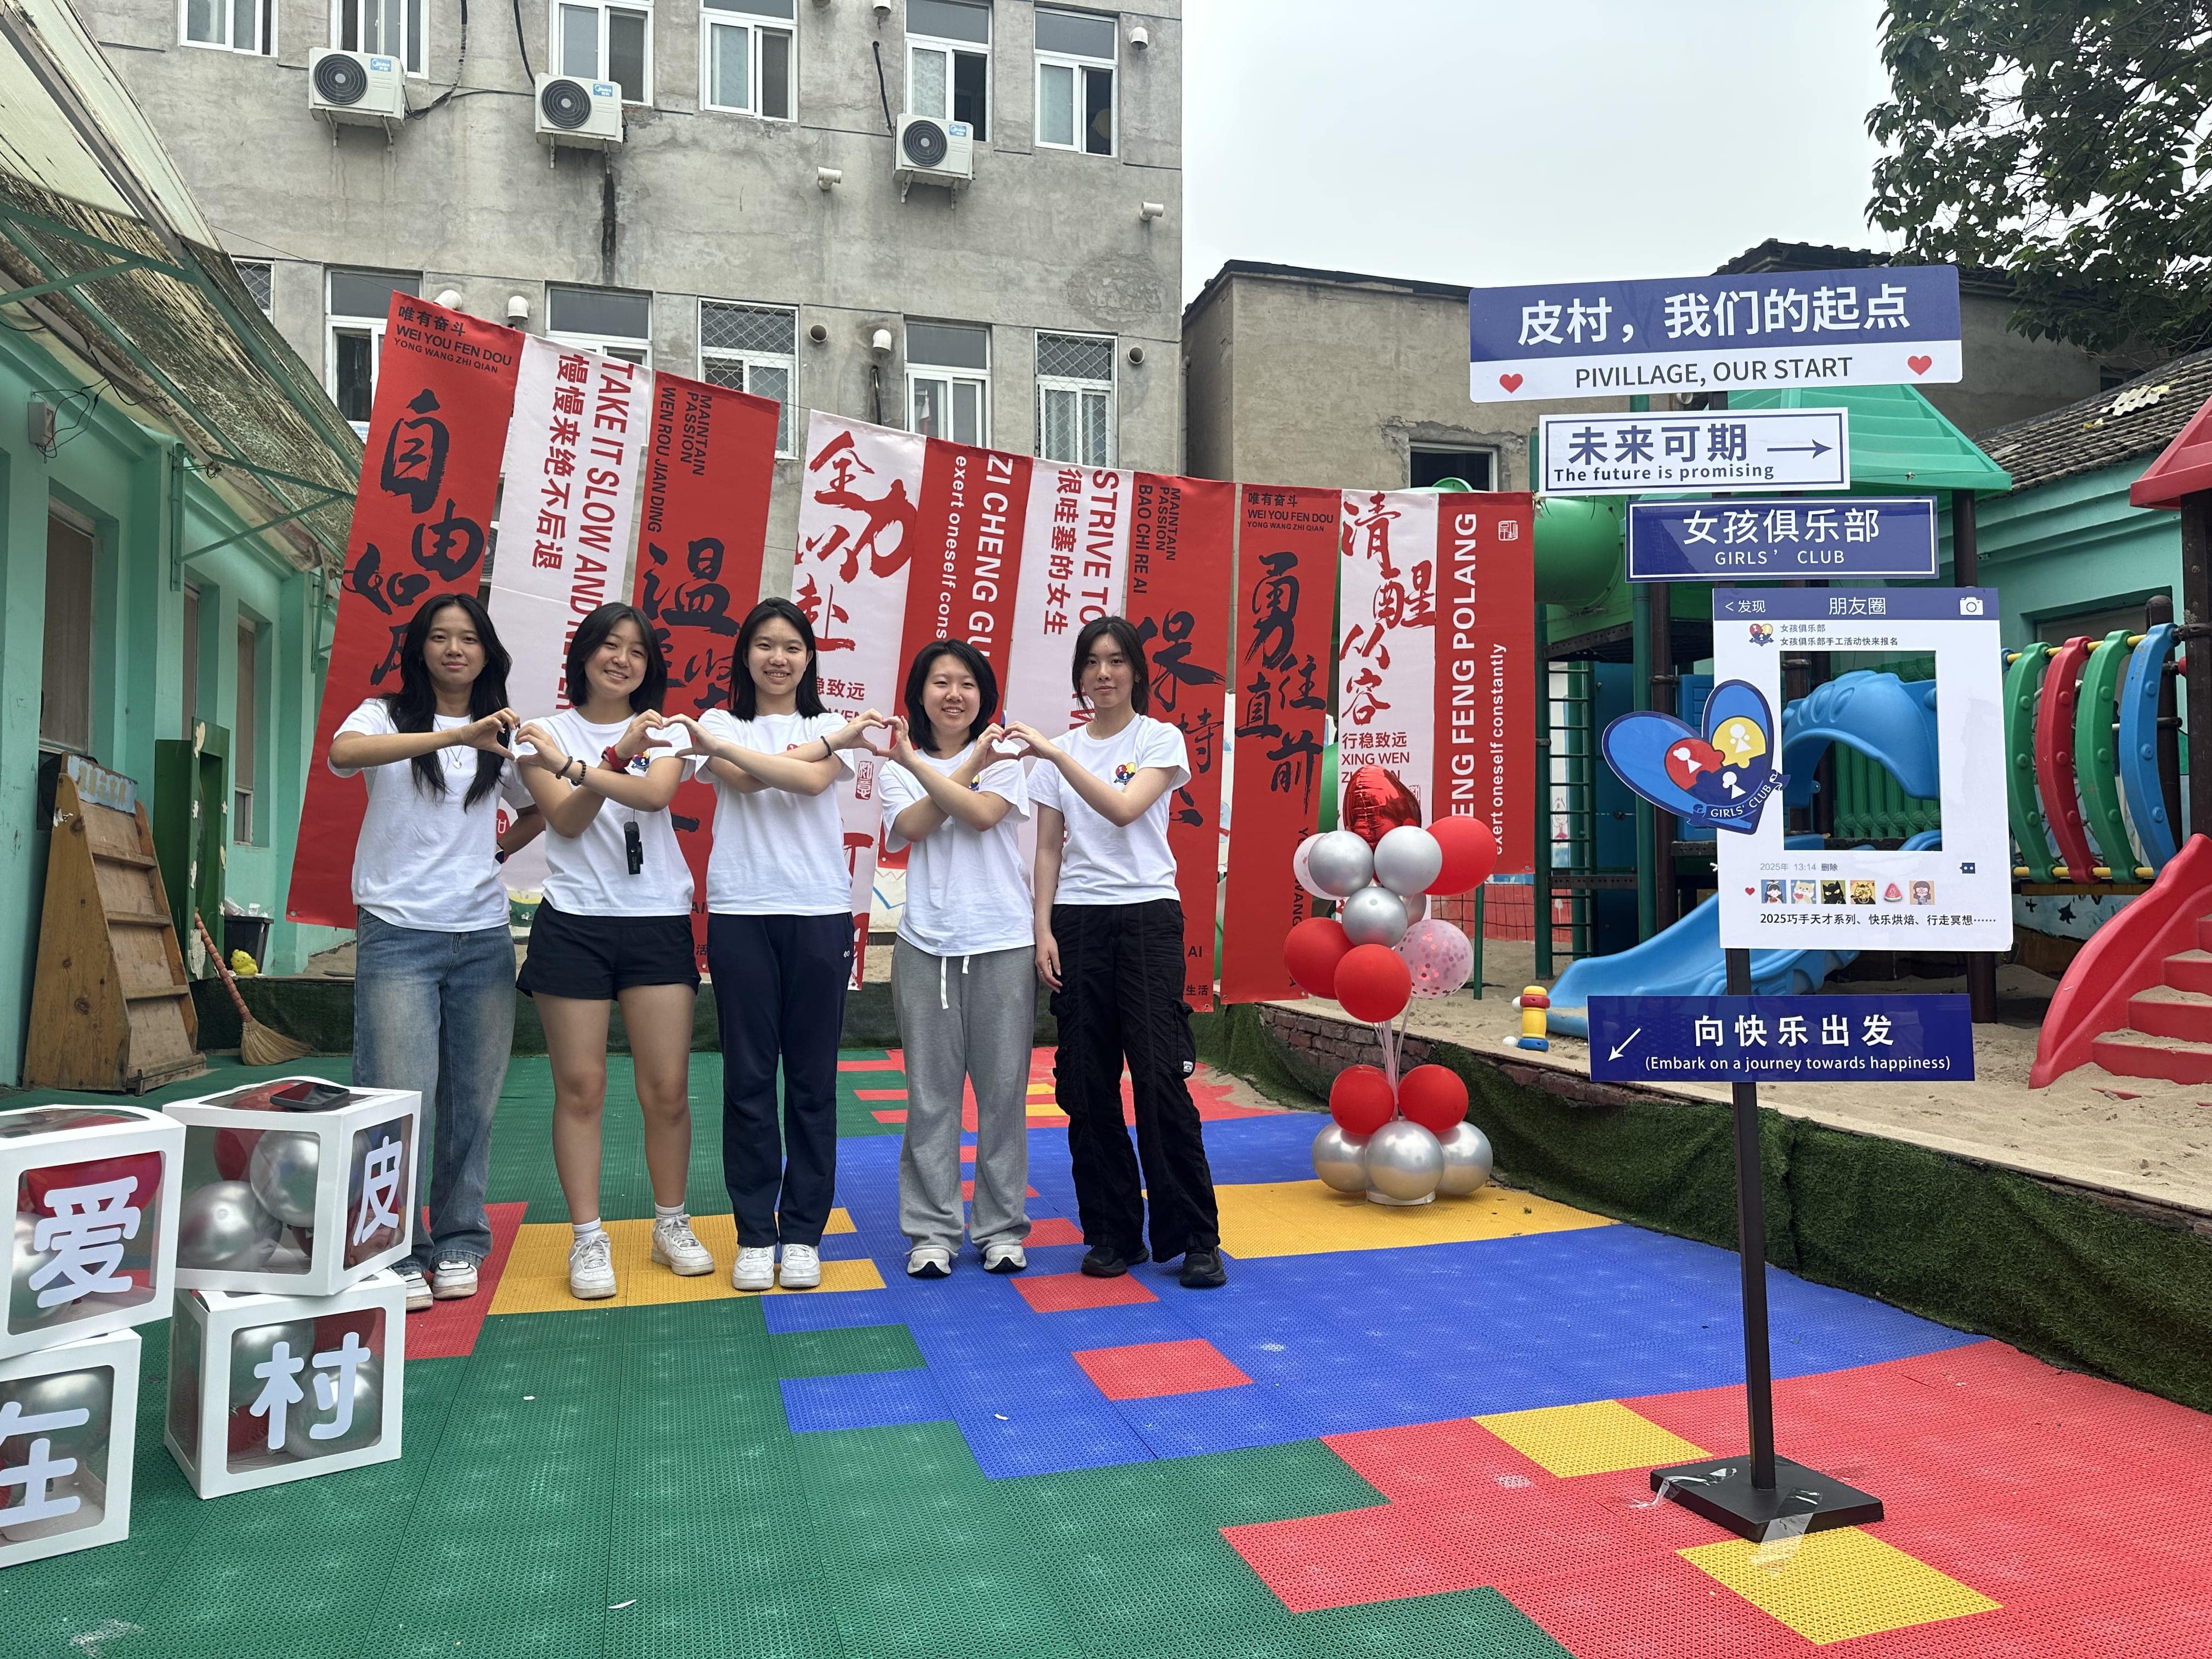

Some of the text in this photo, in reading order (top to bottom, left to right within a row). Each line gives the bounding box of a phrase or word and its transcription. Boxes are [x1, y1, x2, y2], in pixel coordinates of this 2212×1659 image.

[398, 306, 465, 337] 唯有奋斗
[1518, 283, 1910, 346] 皮村，我们的起点
[394, 338, 498, 374] YONG WANG ZHI QIAN
[397, 324, 512, 366] WEI YOU FEN DOU
[1576, 357, 1853, 388] PIVILLAGE, OUR START
[680, 391, 699, 464] PASSION
[692, 394, 713, 476] MAINTAIN
[1568, 423, 1747, 465] 未来可期
[532, 353, 590, 569] 慢慢来绝不后退
[647, 387, 676, 533] WEN ROU JIAN DING
[950, 456, 967, 508] exert
[986, 454, 1014, 484] ZI
[1554, 463, 1774, 482] The future is promising
[570, 362, 635, 615] TAKE IT SLOW AND
[1248, 492, 1297, 507] 唯有奋斗
[1083, 470, 1120, 579] STRIVE
[1133, 484, 1153, 594] BAO CHI RE AI
[1155, 487, 1170, 551] PASSION
[1166, 488, 1181, 561] MAINTAIN
[1248, 509, 1334, 523] WEI YOU FEN DOU
[1683, 508, 1879, 545] 女孩俱乐部
[941, 512, 961, 589] oneself
[972, 492, 1008, 603] CHENG
[1043, 467, 1083, 636] 很哇塞的女生
[1797, 550, 1844, 565] CLUB
[1453, 514, 1476, 650] POLANG
[1340, 491, 1436, 725] 清醒从容
[1738, 600, 1766, 613] 发现
[1780, 624, 1826, 633] 女孩俱乐部
[1829, 597, 1887, 615] 朋友圈
[1780, 637, 1898, 646] 女孩俱乐部手工活动快来报名
[1234, 551, 1327, 816] 勇往直前
[1452, 660, 1475, 744] FENG
[1490, 644, 1507, 738] constantly
[1341, 752, 1409, 766] XING WEN
[1342, 731, 1407, 749] 行稳致远
[1490, 742, 1503, 807] oneself
[1749, 785, 1771, 808] CLUB
[1760, 863, 1788, 871] 2025年
[1821, 863, 1838, 871] 删除
[1188, 946, 1203, 957] AI
[1186, 984, 1209, 996] 生活
[1695, 1014, 1894, 1047] 向快乐出发
[1646, 1056, 1951, 1073] (Embark on a journey towards happiness)
[353, 1136, 402, 1246] 皮
[29, 1176, 141, 1308] 爱
[249, 1331, 371, 1451] 村
